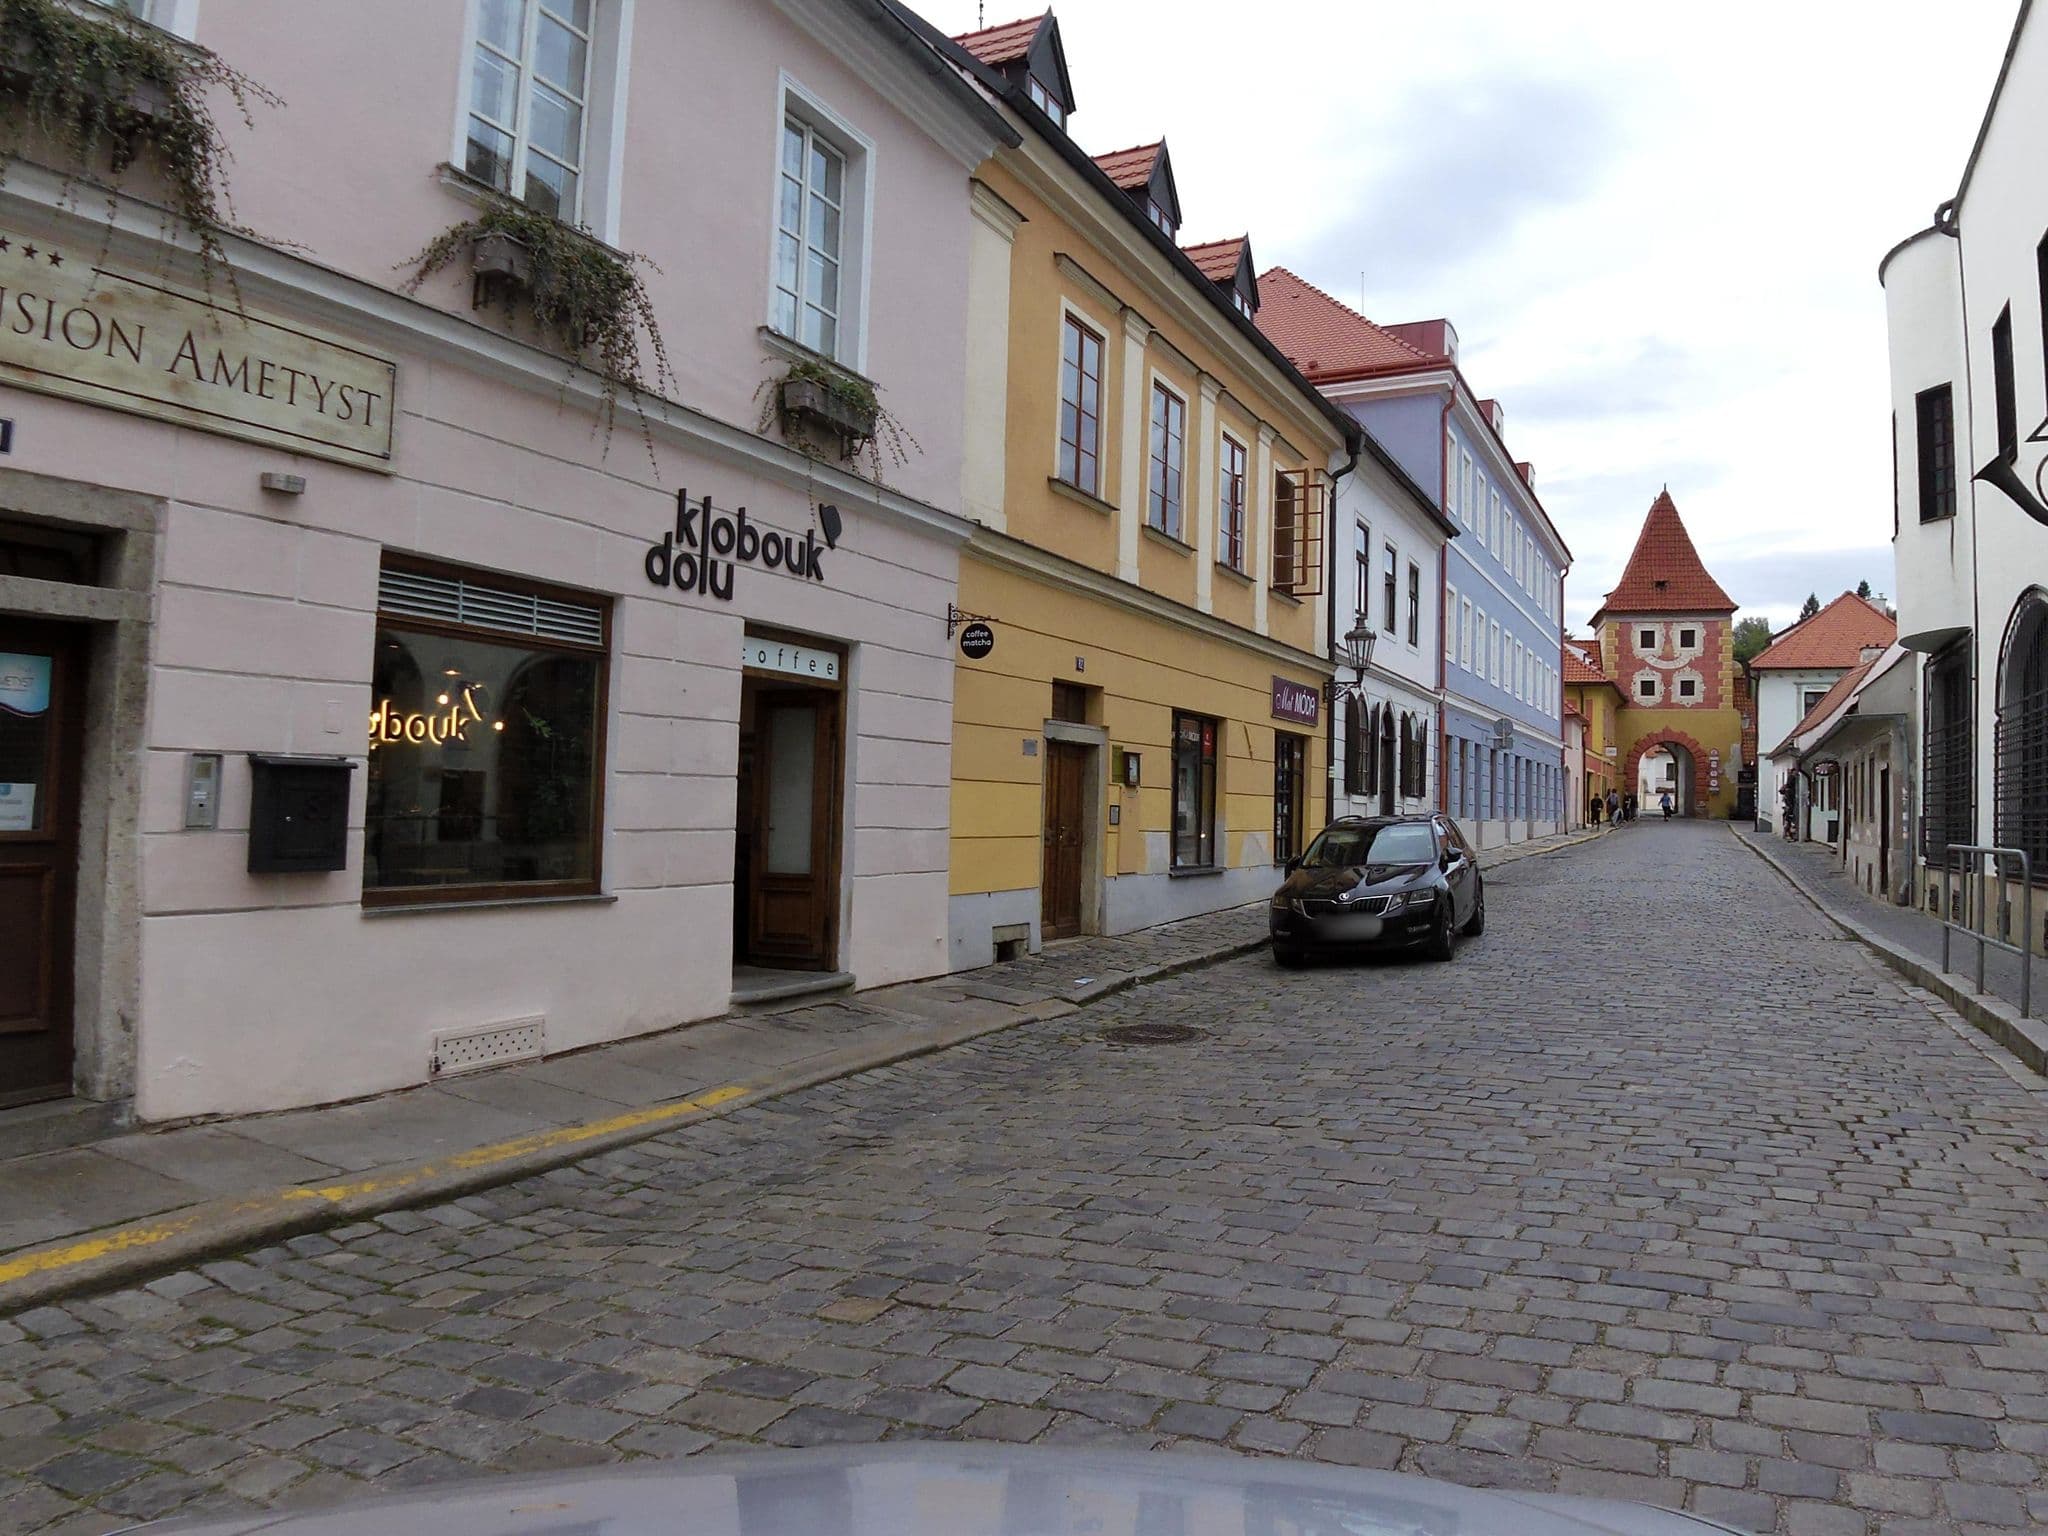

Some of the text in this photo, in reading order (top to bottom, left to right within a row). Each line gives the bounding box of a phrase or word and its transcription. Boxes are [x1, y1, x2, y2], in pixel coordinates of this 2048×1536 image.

[165, 330, 382, 427] AMETYST
[645, 518, 735, 601] dolu
[676, 488, 825, 594] klobouk
[966, 630, 989, 638] coffee
